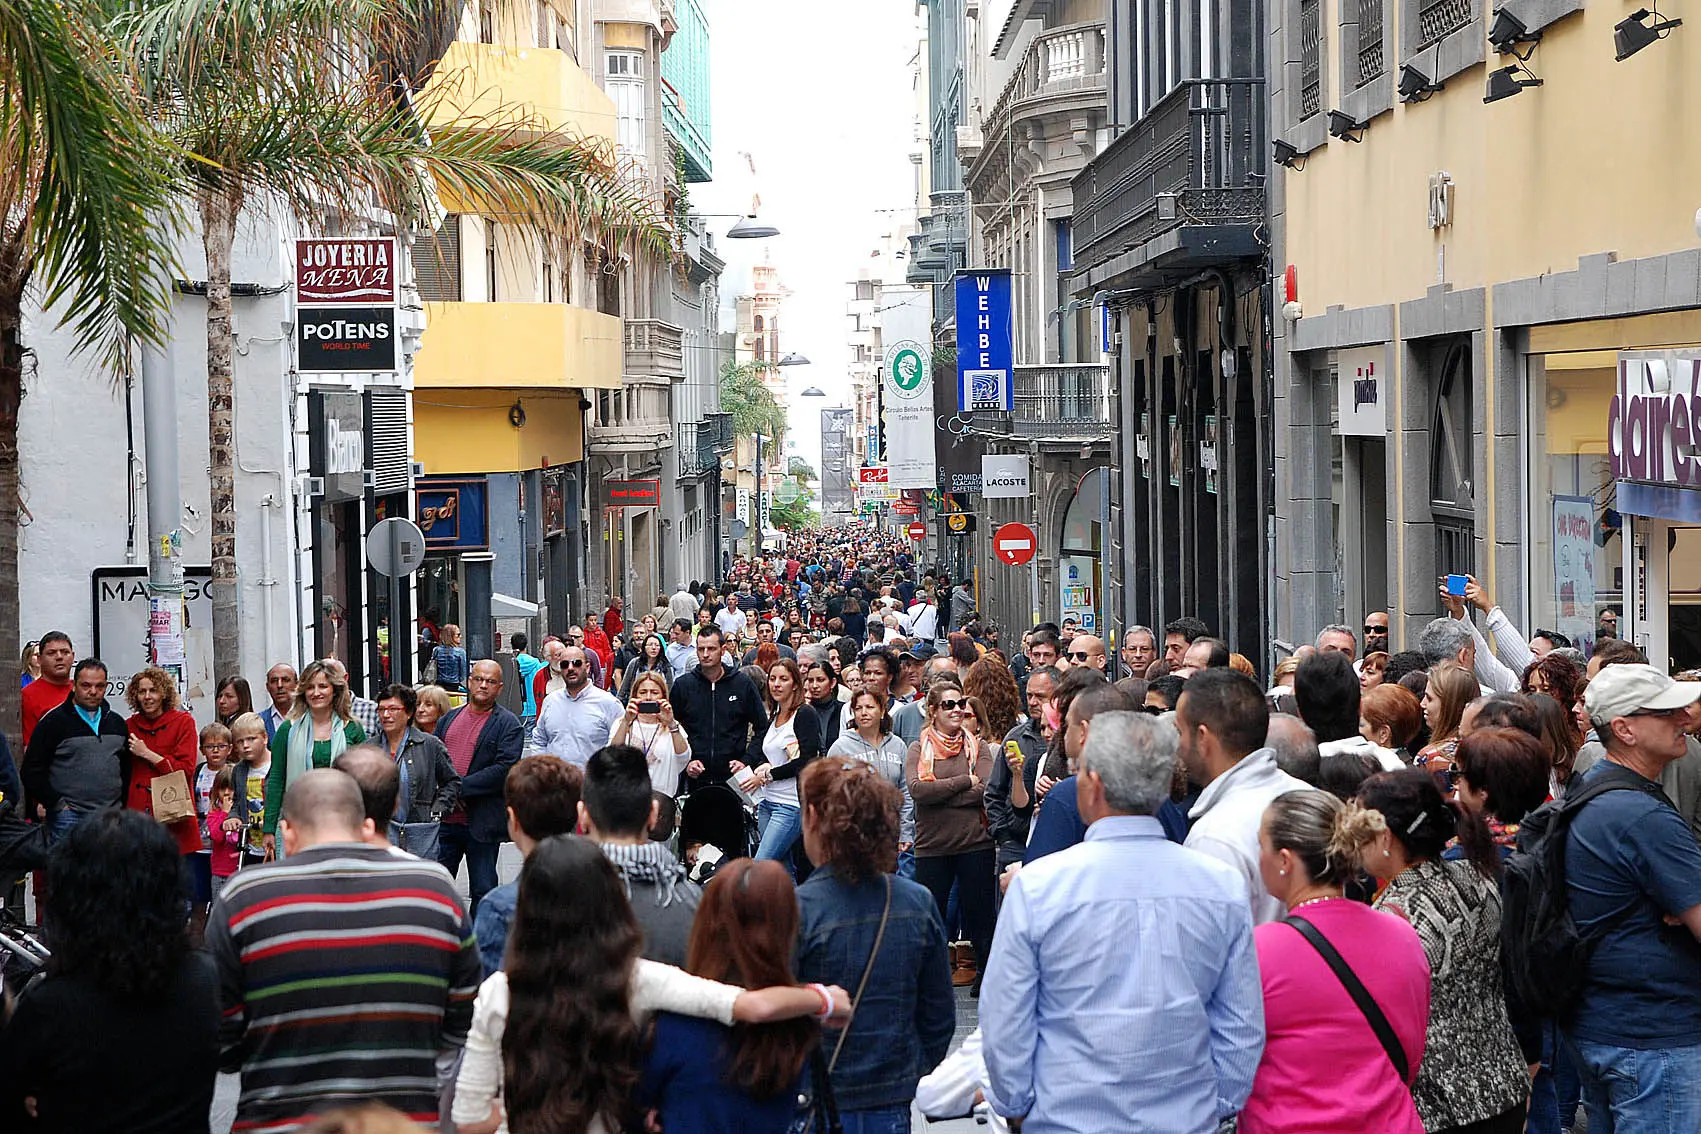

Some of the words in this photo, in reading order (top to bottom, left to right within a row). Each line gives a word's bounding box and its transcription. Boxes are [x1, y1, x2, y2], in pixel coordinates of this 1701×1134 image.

[302, 244, 388, 267] JOYERIA
[300, 266, 389, 287] MENA
[303, 320, 390, 340] POTENS
[976, 276, 990, 368] WEHBE
[322, 342, 350, 350] WORLD
[353, 342, 370, 350] TIME
[986, 478, 1026, 486] LACOSTE
[739, 490, 747, 521] FARMACI
[101, 580, 213, 602] MAG
